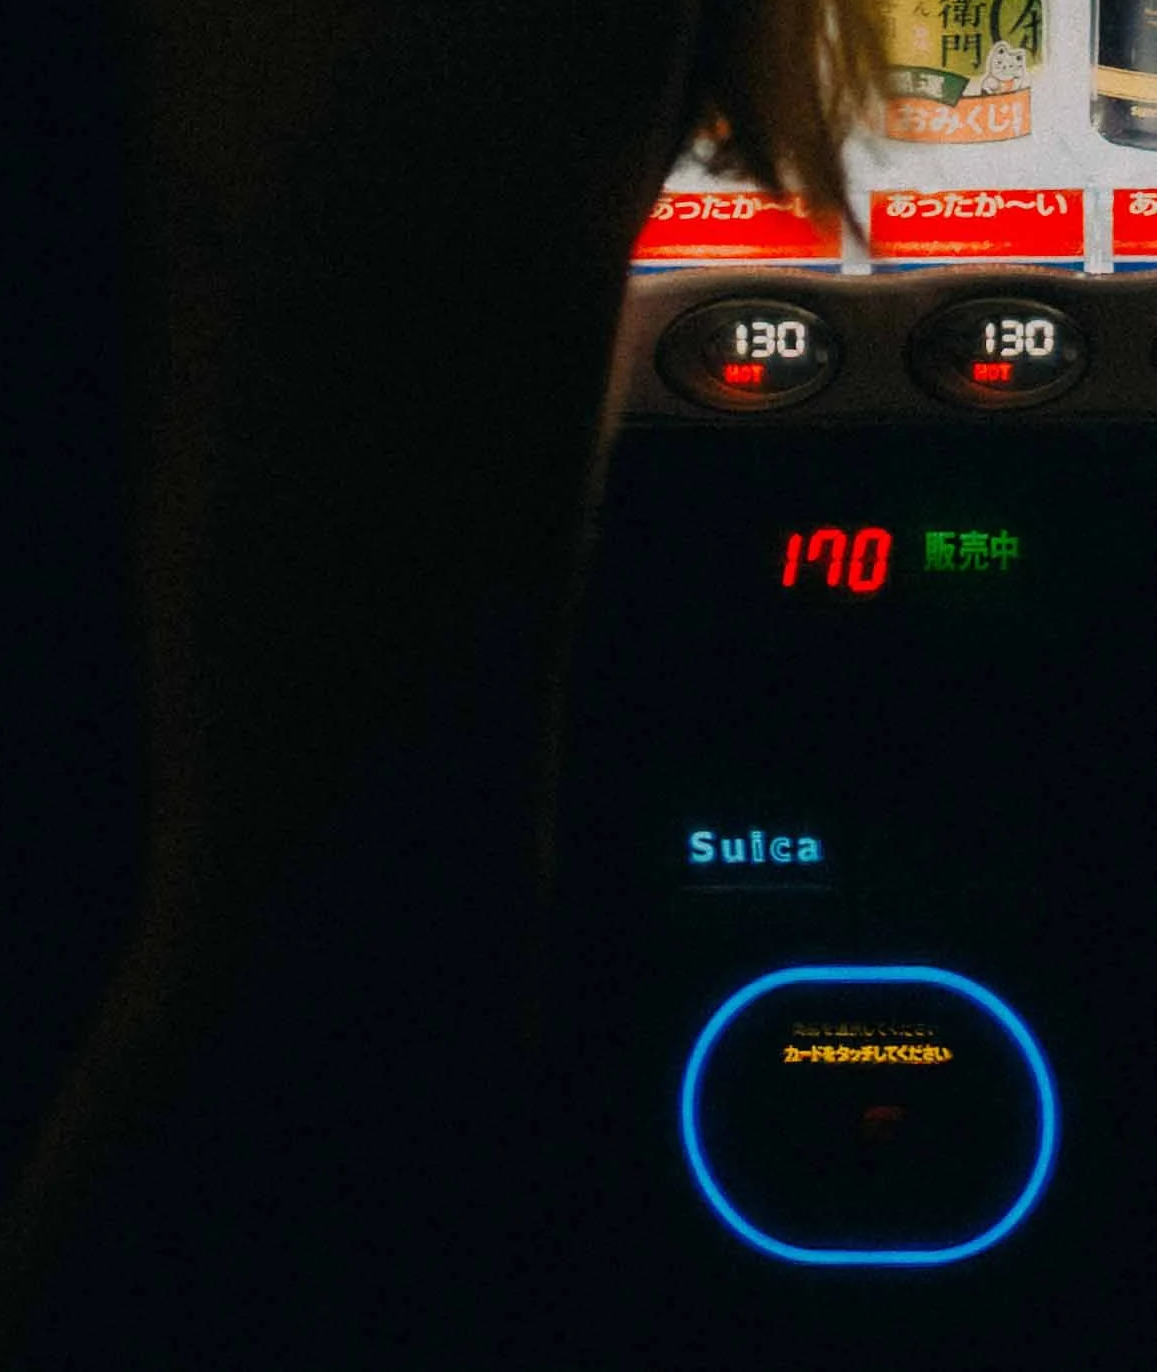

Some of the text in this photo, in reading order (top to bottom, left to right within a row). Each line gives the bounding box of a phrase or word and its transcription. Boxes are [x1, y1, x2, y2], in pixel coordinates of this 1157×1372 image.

[734, 320, 807, 358] 130
[984, 319, 1056, 357] 130
[724, 362, 766, 385] HOT
[973, 361, 1014, 383] HOT
[780, 527, 893, 593] 170
[923, 529, 1021, 574] 販売中
[687, 829, 824, 865] Suica
